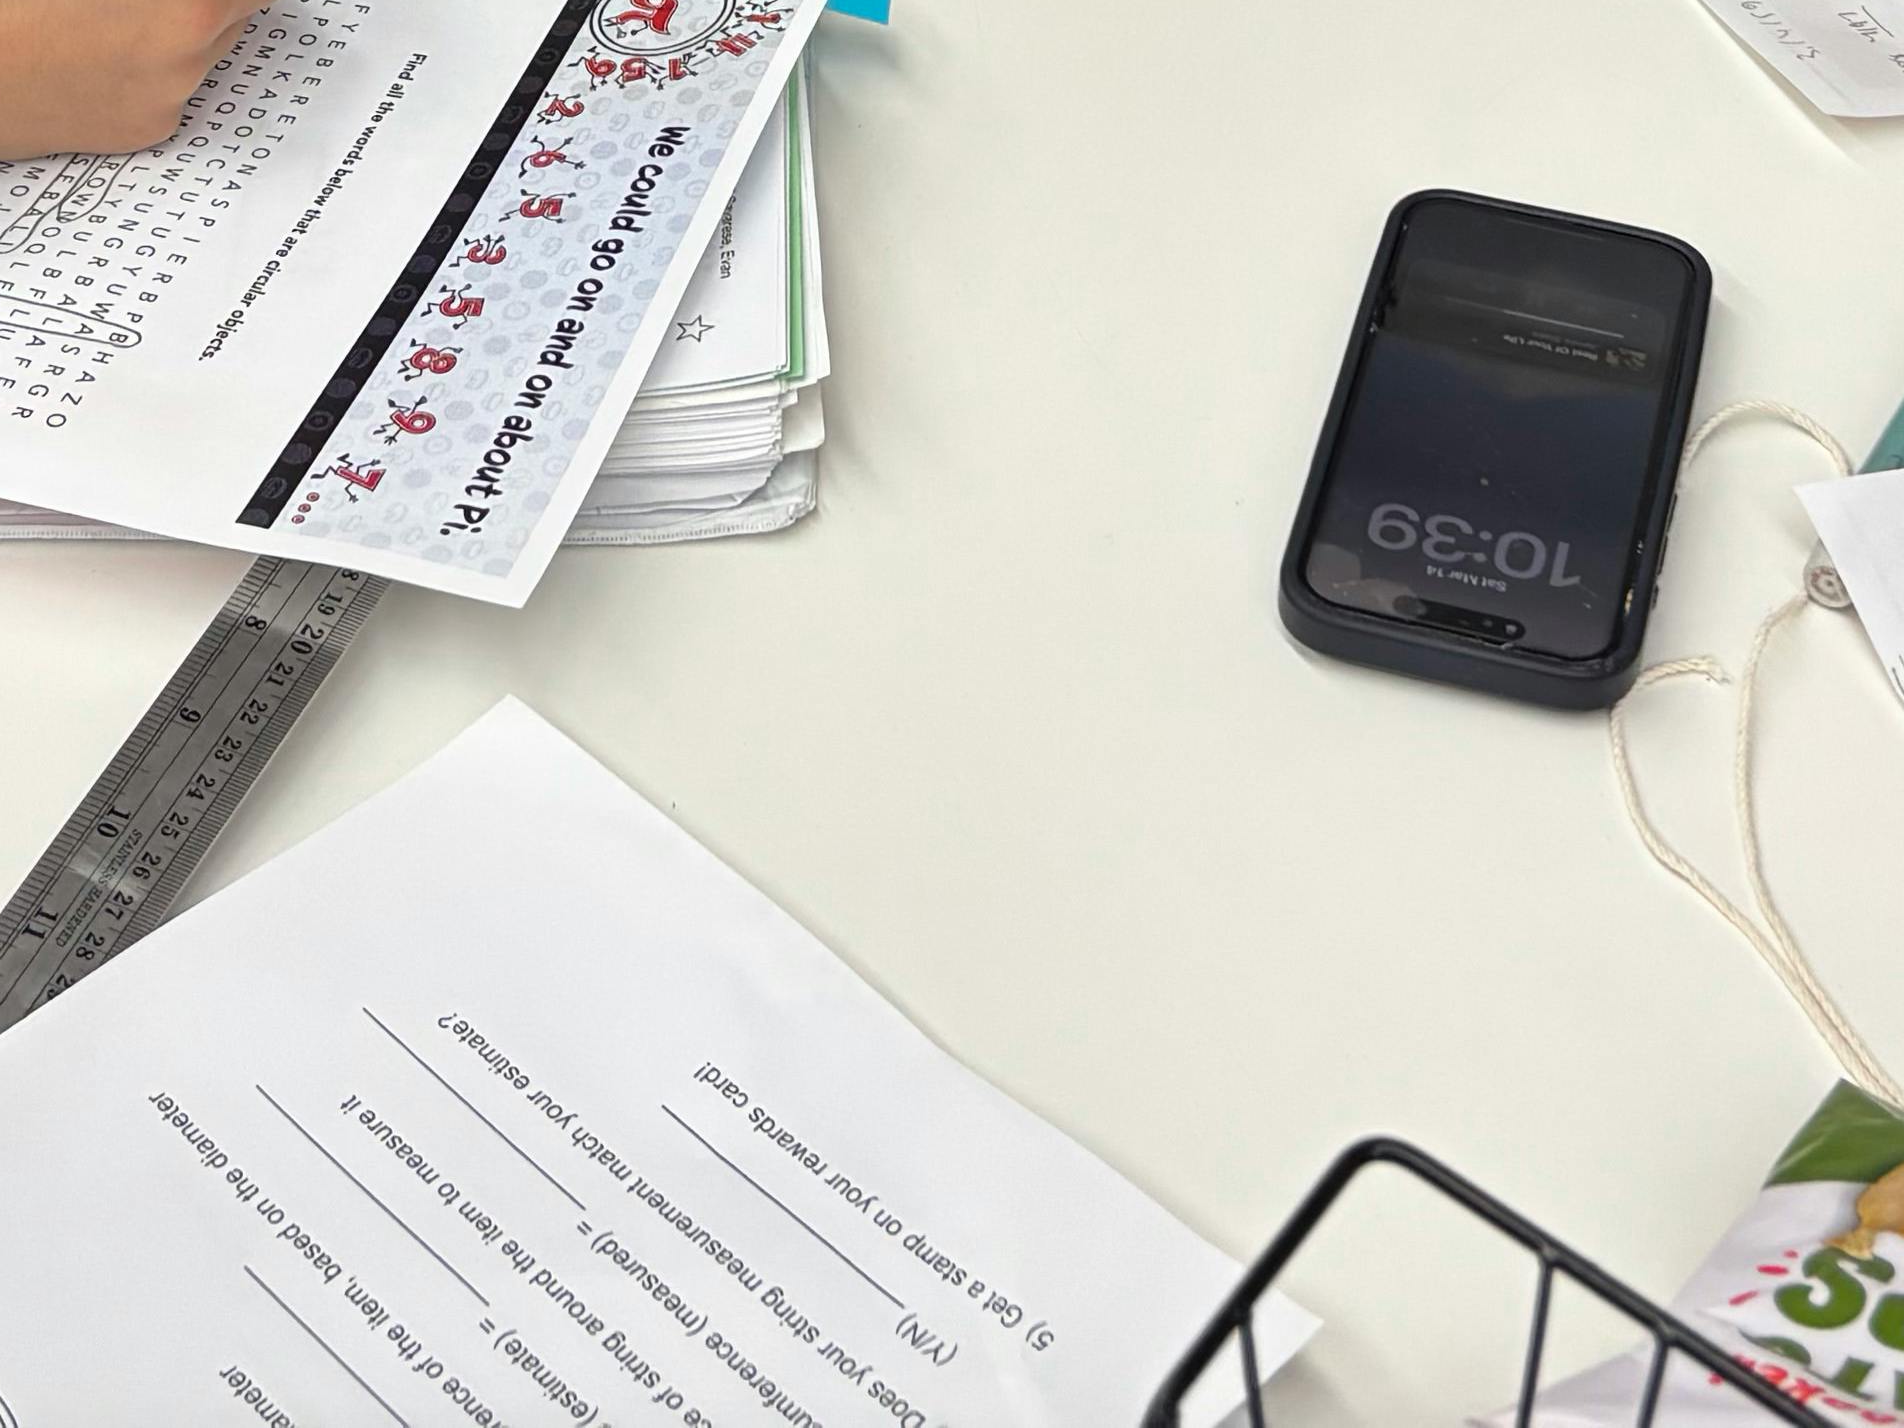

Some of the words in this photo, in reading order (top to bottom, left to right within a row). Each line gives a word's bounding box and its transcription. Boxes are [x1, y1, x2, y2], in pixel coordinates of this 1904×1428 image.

[398, 53, 427, 81] Find
[386, 83, 404, 99] all
[371, 102, 395, 122] the
[342, 127, 375, 173] words
[648, 127, 691, 158] We
[314, 168, 352, 206] below
[609, 164, 663, 233] could
[291, 209, 321, 235] that
[275, 236, 298, 257] are
[590, 239, 624, 271] go
[240, 260, 281, 307] circular
[566, 278, 603, 312] on
[198, 310, 244, 361] objects.
[537, 319, 584, 369] and
[515, 374, 552, 409] on
[465, 415, 534, 499] about
[440, 504, 490, 536] Pi.
[1368, 504, 1580, 587] 10:39
[1481, 577, 1506, 592] Sat
[317, 592, 345, 617] 19
[244, 613, 269, 632] 8
[291, 623, 325, 655] 20
[266, 660, 295, 685] 21
[179, 706, 203, 725] 9
[240, 698, 269, 726] 22
[214, 736, 242, 763] 23
[186, 772, 217, 802] 24
[97, 804, 133, 840] 10
[161, 812, 189, 840] 25
[133, 851, 163, 881] 26
[20, 905, 59, 942] 11
[105, 891, 134, 922] 27
[75, 931, 106, 962] 28
[438, 1013, 530, 1090] estimate?
[693, 1062, 748, 1108] card!
[340, 1095, 361, 1115] it
[526, 1091, 578, 1130] your
[148, 1092, 228, 1168] diameter
[359, 1110, 440, 1184] measure
[748, 1107, 828, 1176] rewards
[571, 1127, 632, 1181] match
[226, 1168, 259, 1202] the
[437, 1183, 460, 1206] to
[824, 1173, 879, 1214] your
[257, 1198, 285, 1224] on
[458, 1201, 503, 1245] item
[873, 1209, 903, 1236] on
[626, 1177, 762, 1292] measurement
[276, 1223, 342, 1284] based
[501, 1240, 536, 1274] the
[903, 1234, 967, 1286] stamp
[590, 1231, 708, 1337] (measured)
[967, 1280, 985, 1298] a
[344, 1277, 390, 1331] item,
[529, 1269, 604, 1336] around
[760, 1287, 820, 1343] string
[982, 1291, 1023, 1328] Get
[387, 1325, 422, 1361] the
[895, 1313, 958, 1366] (Y/N)
[1025, 1322, 1054, 1351] 5)
[412, 1356, 444, 1379] of
[602, 1332, 661, 1388] string
[817, 1342, 873, 1386] your
[493, 1330, 599, 1428] (estimate)
[652, 1387, 684, 1410] of
[868, 1381, 926, 1428] Does
